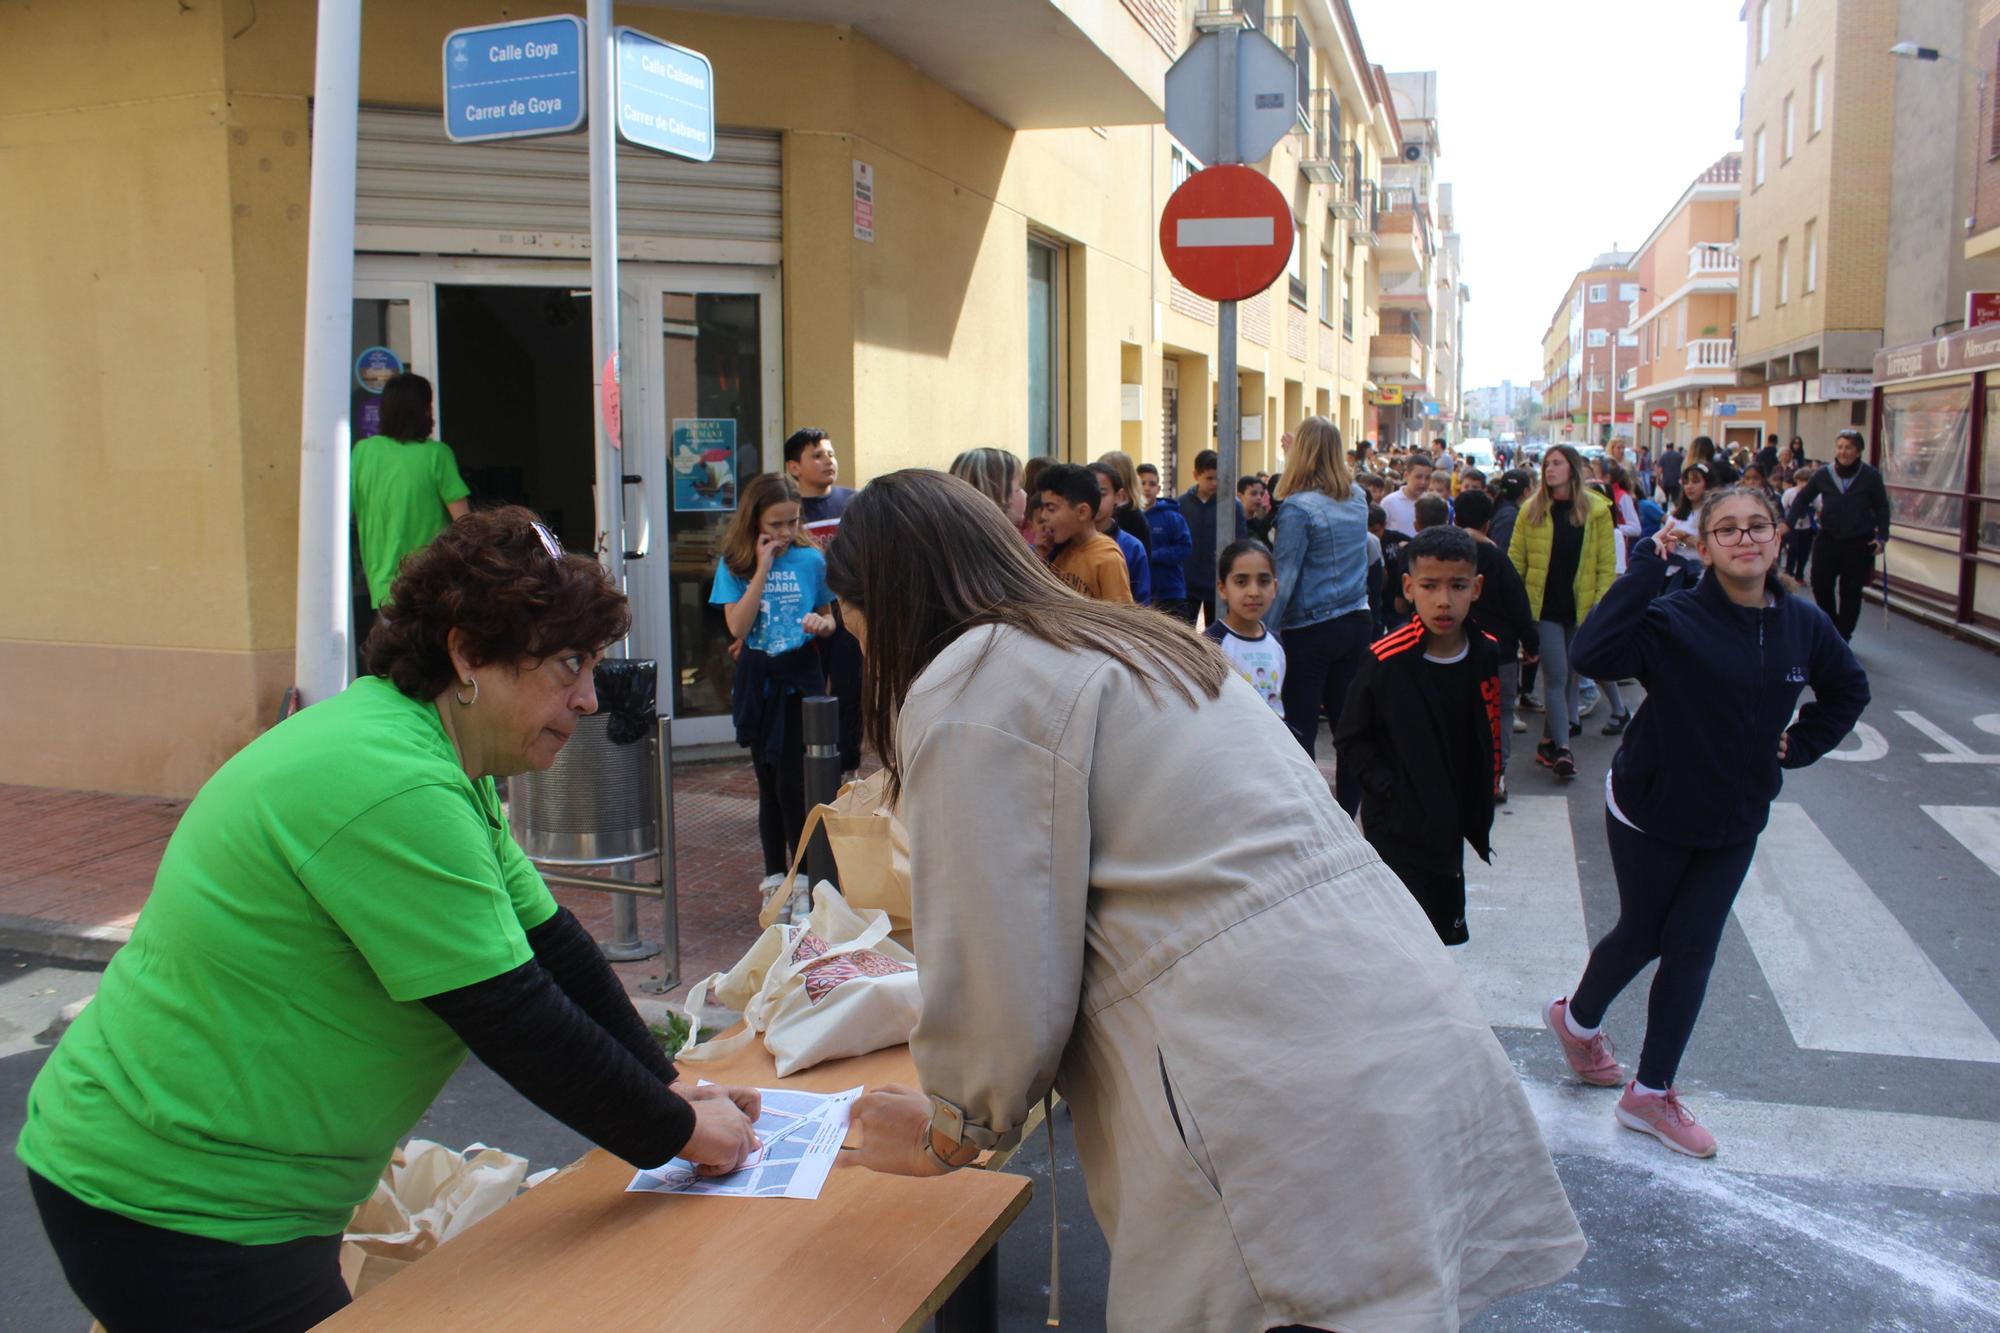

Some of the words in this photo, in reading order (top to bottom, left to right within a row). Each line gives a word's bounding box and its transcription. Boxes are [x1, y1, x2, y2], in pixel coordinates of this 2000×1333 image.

[488, 45, 522, 62] Calle
[525, 42, 559, 60] Goya
[641, 55, 666, 77] Calle
[666, 63, 705, 90] Cabanes
[465, 105, 506, 121] Carrer
[508, 100, 525, 116] de
[528, 97, 562, 115] Goya
[623, 103, 654, 126] Carrer
[655, 114, 668, 131] de
[668, 118, 706, 143] Cabanes
[767, 571, 797, 581] URSA
